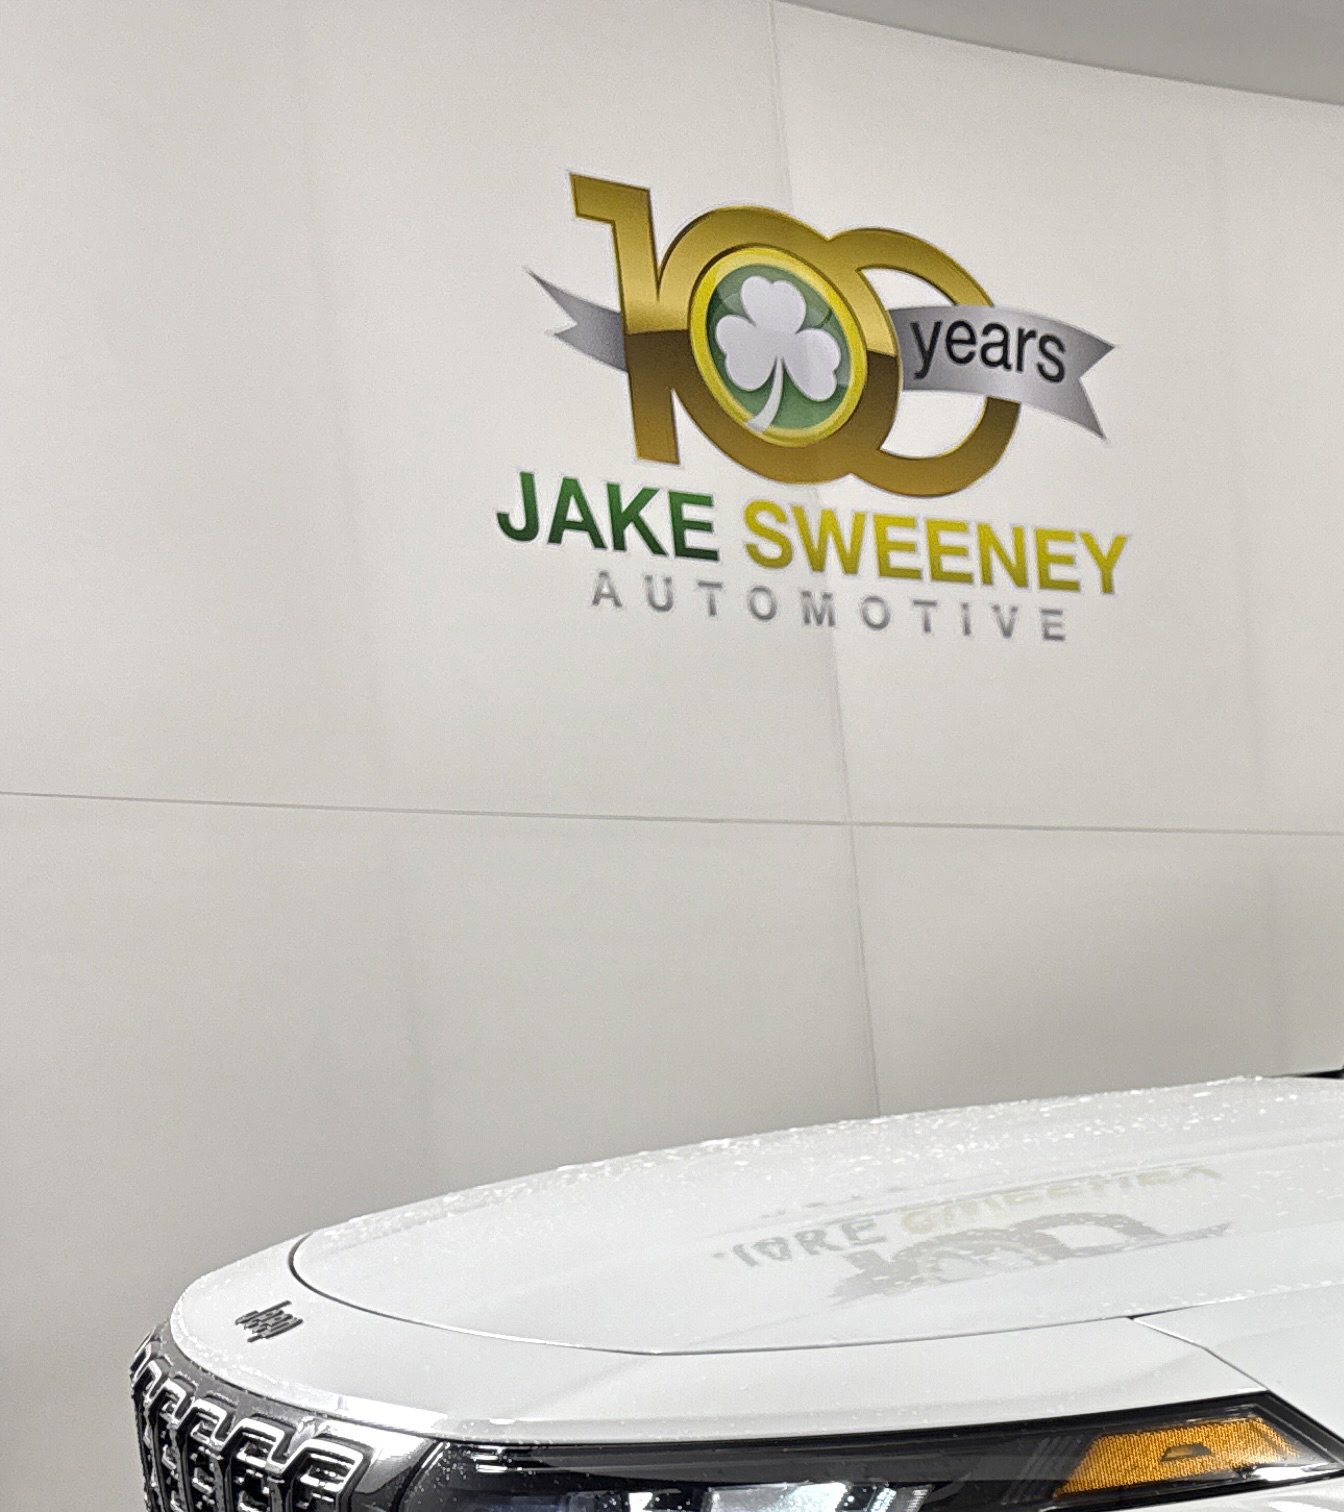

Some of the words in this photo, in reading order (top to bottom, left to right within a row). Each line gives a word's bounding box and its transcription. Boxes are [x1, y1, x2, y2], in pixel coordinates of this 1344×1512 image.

[570, 172, 1021, 498] 100
[910, 319, 1067, 384] years
[497, 471, 720, 562] JAKE
[744, 499, 1129, 595] SWEENEY
[592, 570, 1067, 641] AUTOMOTIVE
